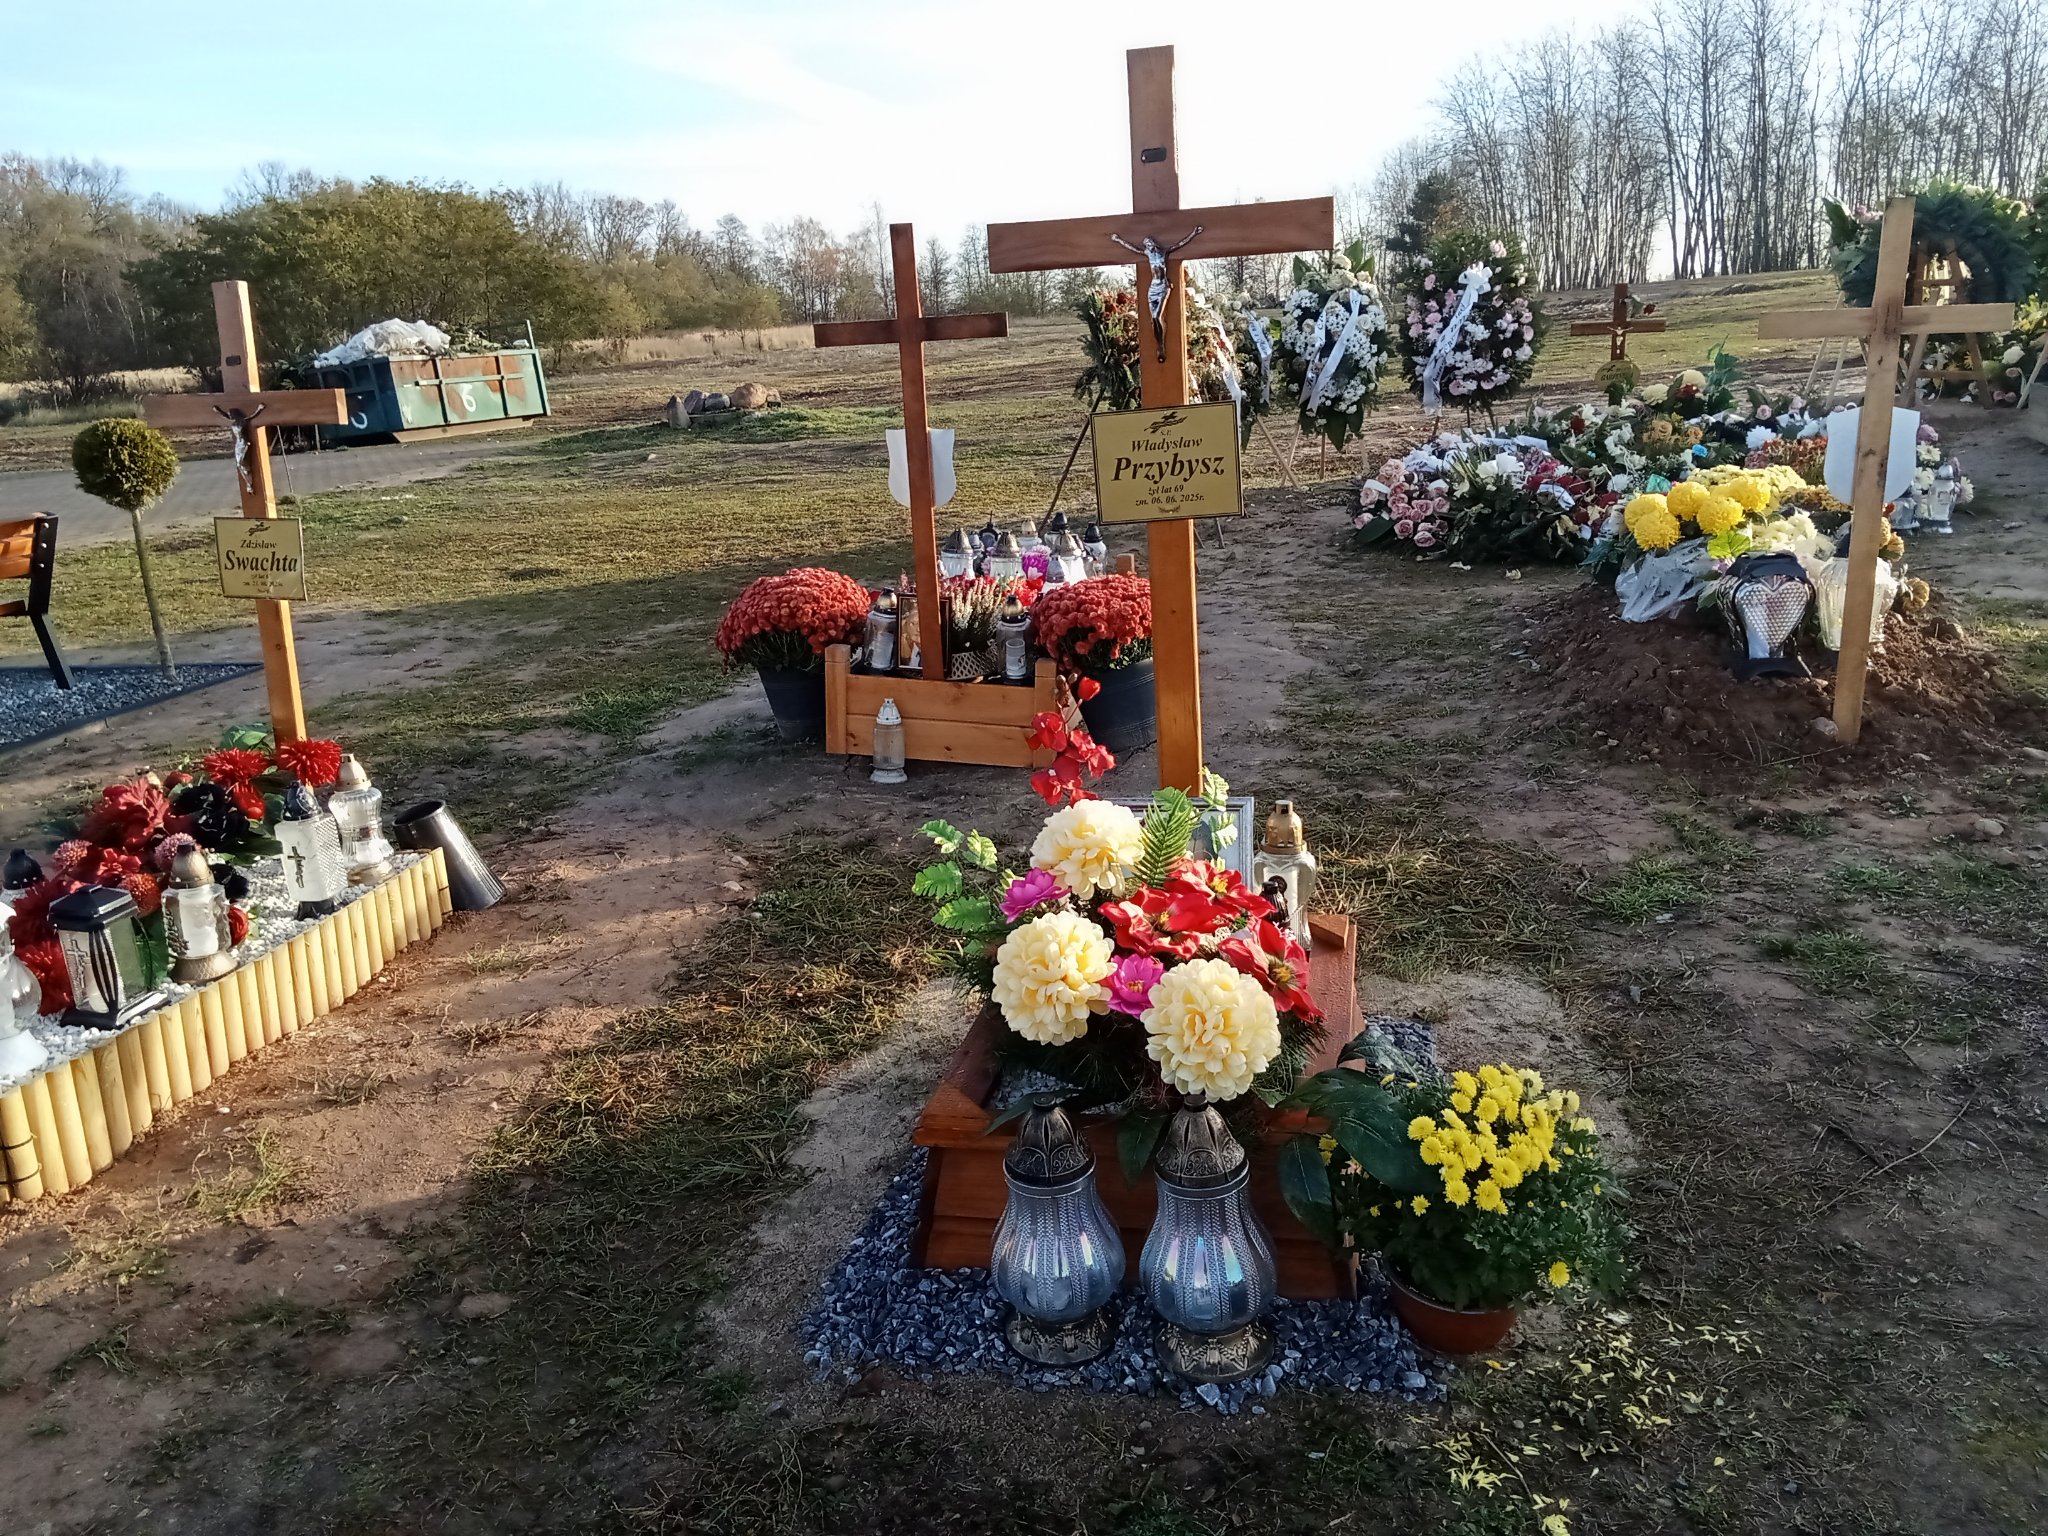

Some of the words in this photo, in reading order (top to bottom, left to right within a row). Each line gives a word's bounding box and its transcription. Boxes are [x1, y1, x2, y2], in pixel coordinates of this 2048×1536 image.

[1131, 436, 1203, 453] Władysław
[1111, 452, 1225, 485] Przybysz
[1161, 485, 1172, 494] lat
[1174, 484, 1184, 493] 69
[1151, 497, 1163, 505] 06.
[1165, 496, 1178, 504] 06.
[1180, 493, 1205, 503] 2025r.
[224, 549, 298, 572] Swachta
